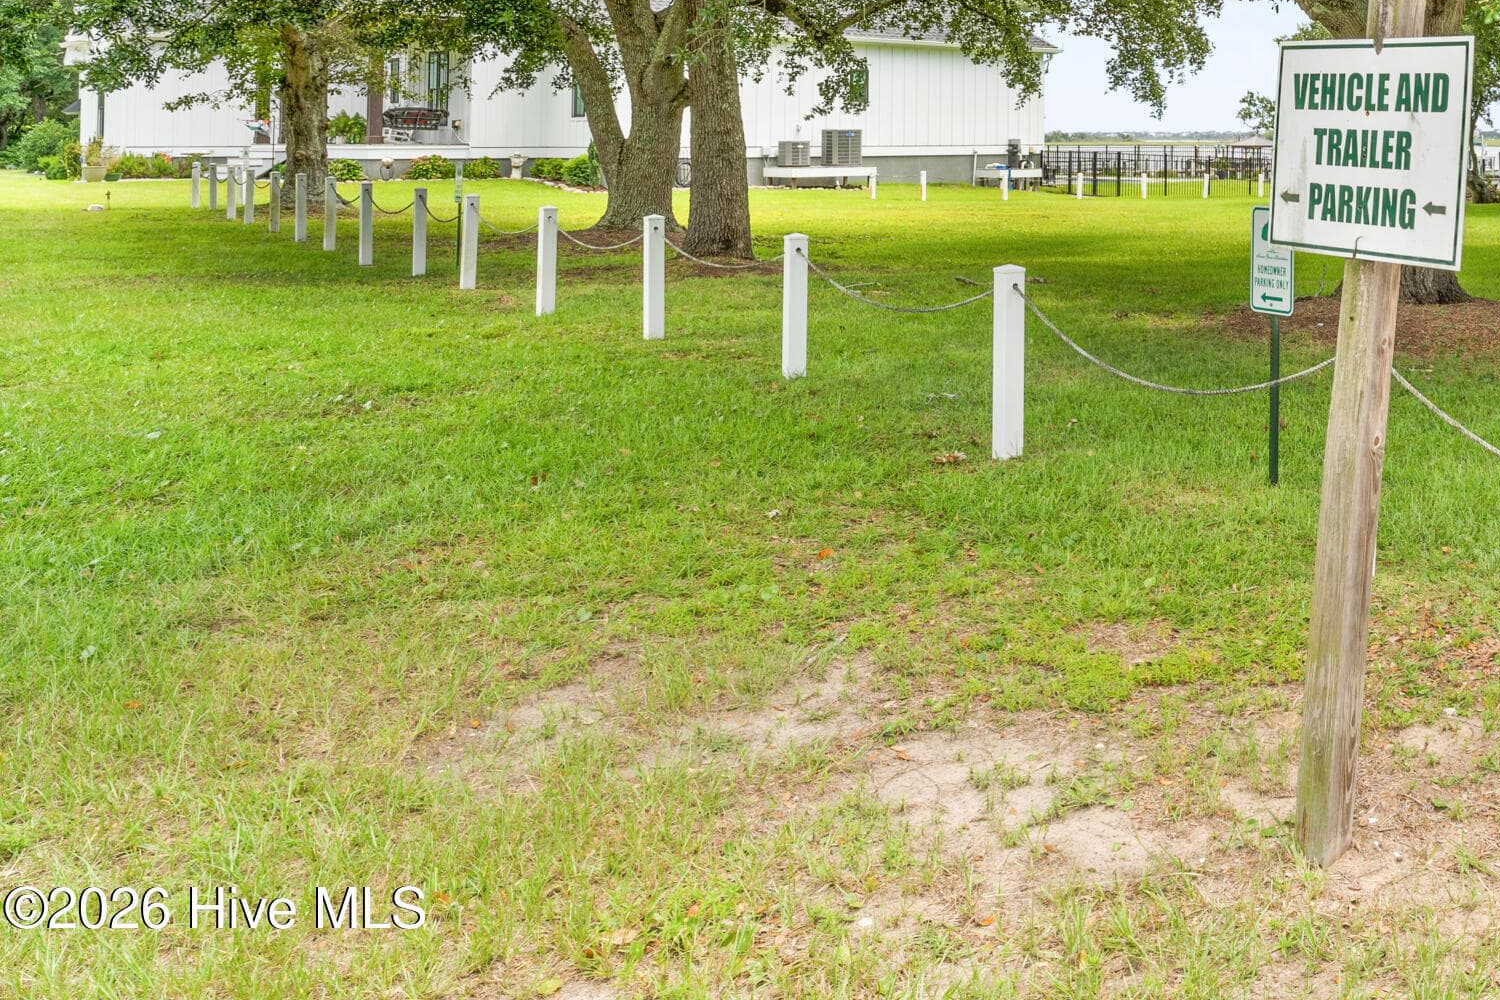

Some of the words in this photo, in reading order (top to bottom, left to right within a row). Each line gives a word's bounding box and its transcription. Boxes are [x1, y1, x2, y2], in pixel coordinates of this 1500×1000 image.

[1293, 72, 1390, 112] VEHICLE
[1394, 72, 1450, 113] AND
[1313, 128, 1412, 170] TRAILER
[1307, 182, 1417, 230] PARKING
[1254, 276, 1275, 289] PARKING
[1276, 279, 1289, 290] ONLY
[1257, 264, 1287, 277] HOMEOWNER
